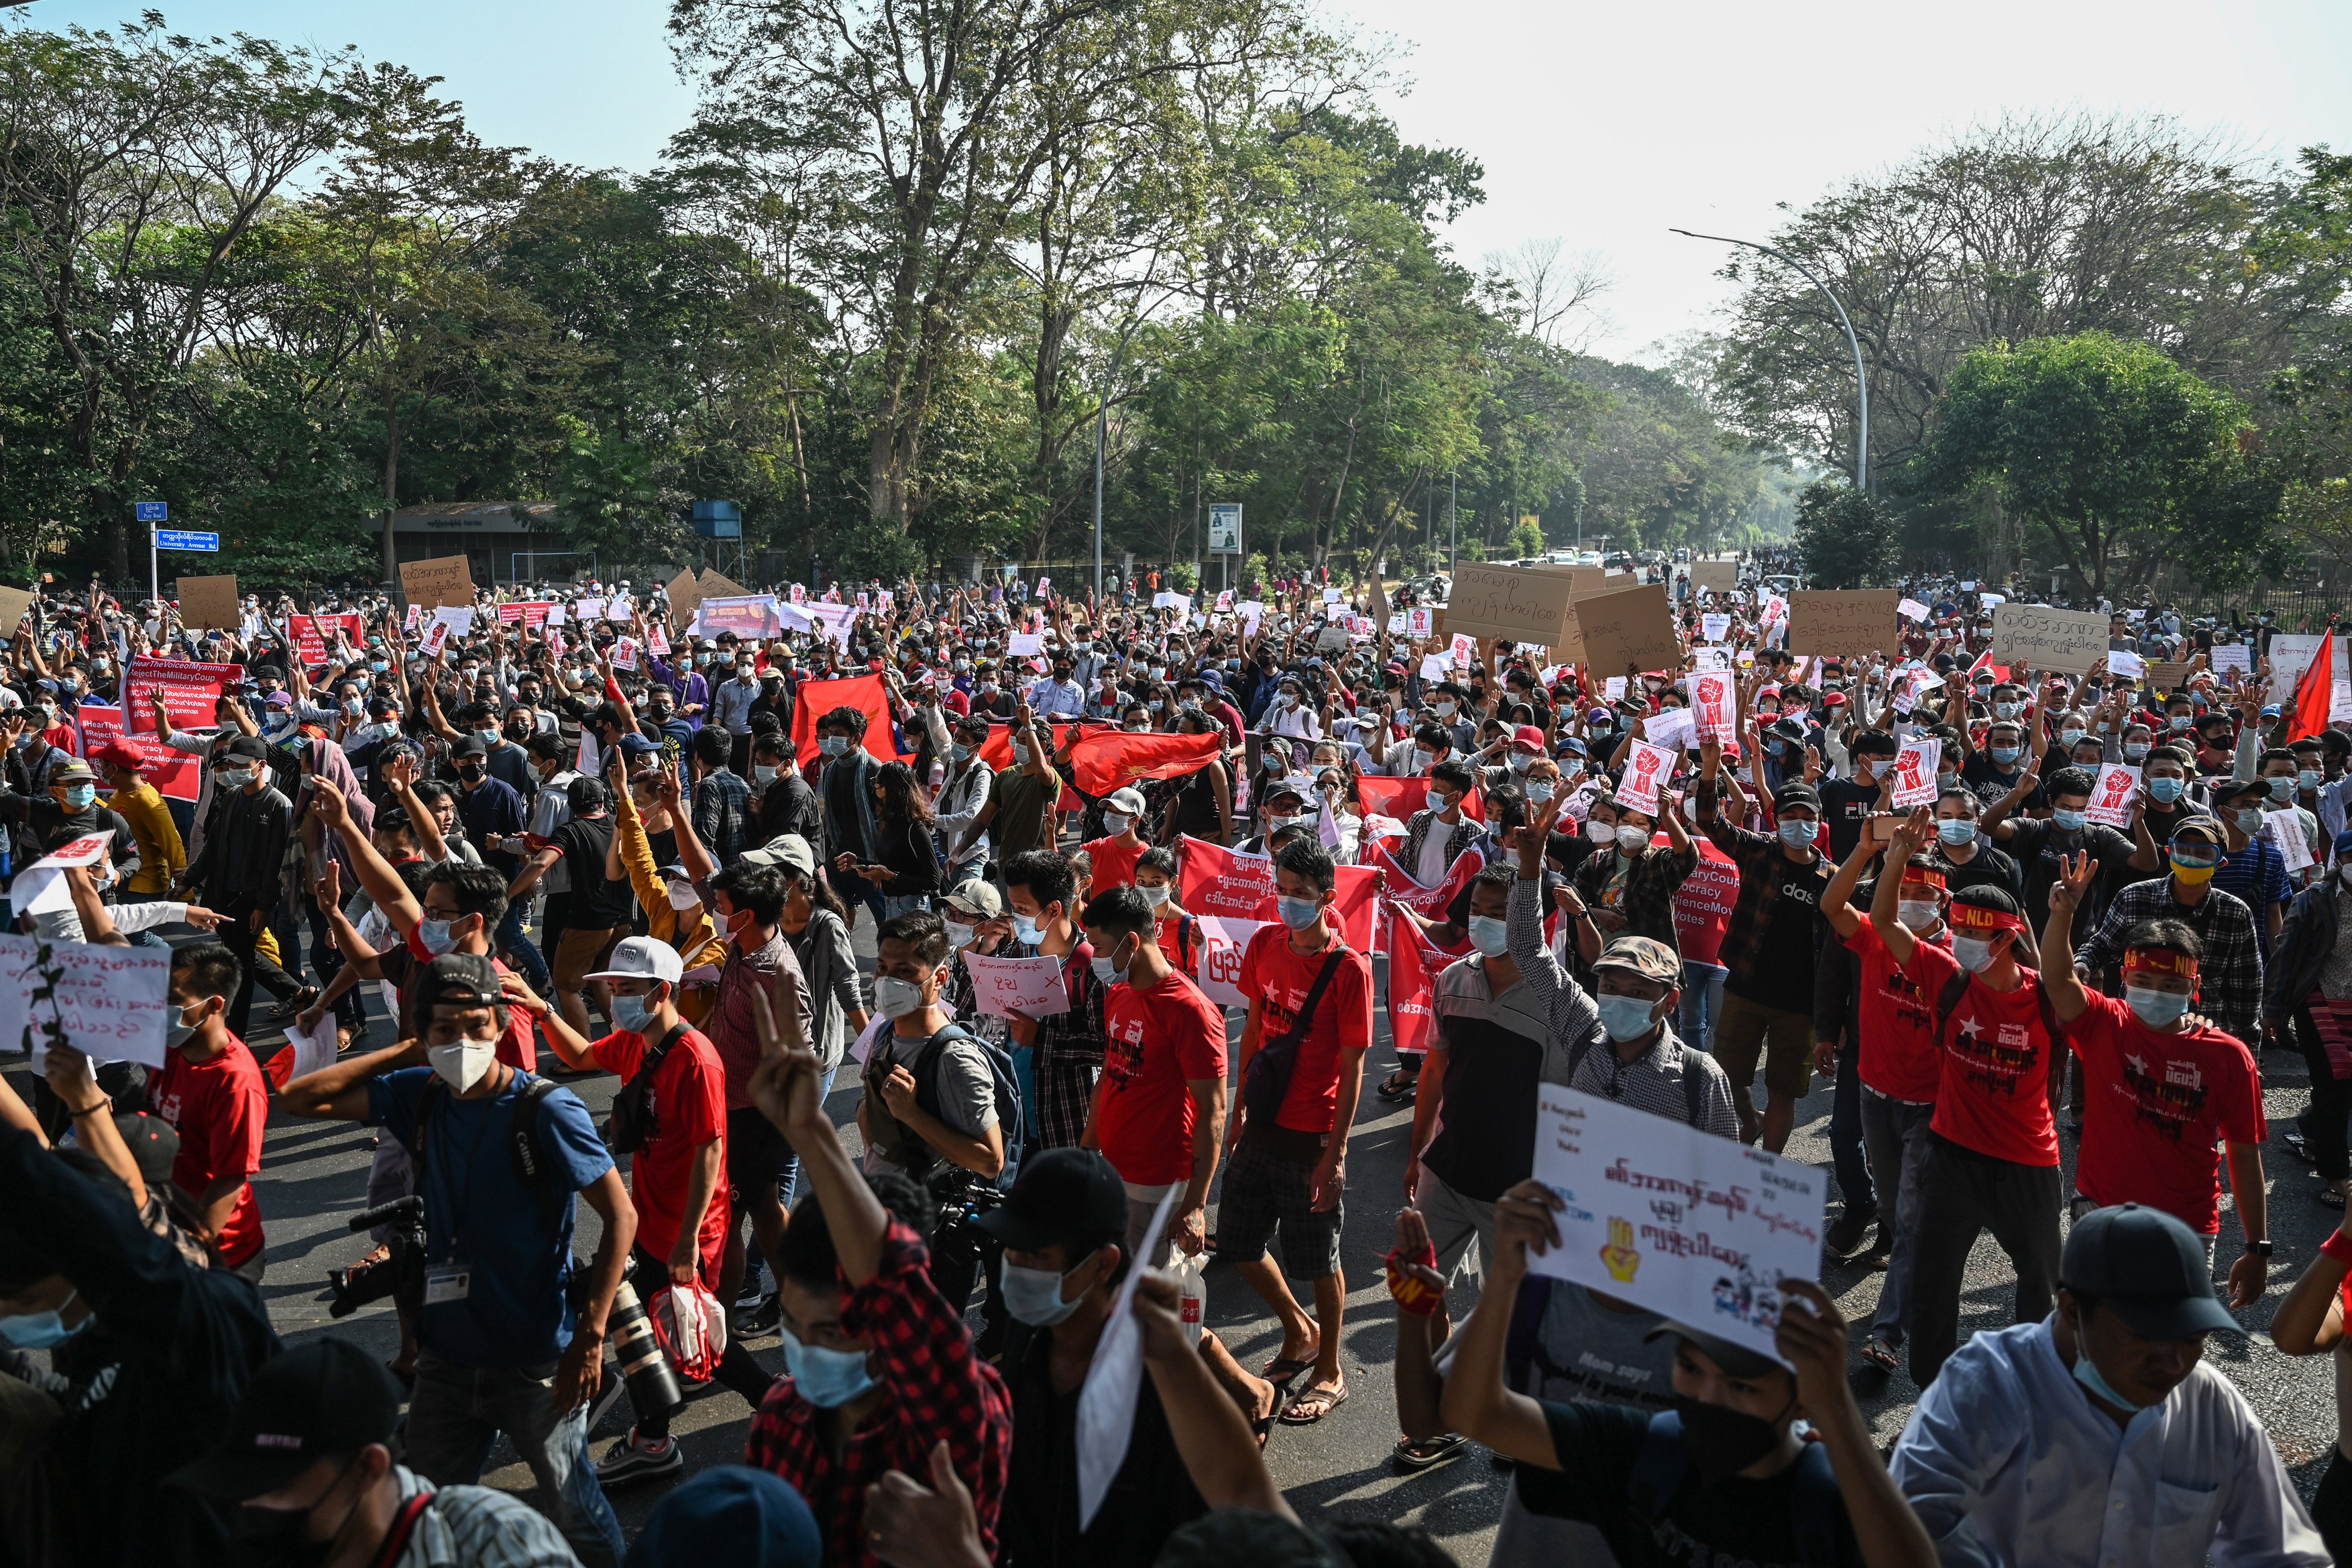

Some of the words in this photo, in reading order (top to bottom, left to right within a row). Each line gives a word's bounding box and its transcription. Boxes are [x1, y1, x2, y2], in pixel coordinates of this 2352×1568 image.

[160, 541, 185, 549] University
[133, 660, 229, 673] HearTheVoiceofMyanmar
[132, 699, 208, 708] #ResctOurVotes
[133, 708, 199, 718] #SavMyanmar
[82, 720, 123, 730] #HearTheV
[664, 735, 680, 750] HIGH
[144, 754, 198, 765] nceMovement
[1845, 801, 1868, 816] FIL
[1691, 870, 1740, 887] aryCoup
[1924, 871, 1940, 886] NLD
[1681, 882, 1722, 899] ocracy
[1205, 890, 1260, 911] ဒေါ်အောင်ဆ
[1673, 895, 1733, 916] dienceMov
[1966, 909, 1994, 927] NLD
[2175, 955, 2196, 976] NLD
[1419, 983, 1433, 997] NL
[2156, 1108, 2170, 1116] NLD
[516, 1131, 535, 1176] Canon
[1578, 1349, 1614, 1373] Mom
[1616, 1365, 1653, 1383] says
